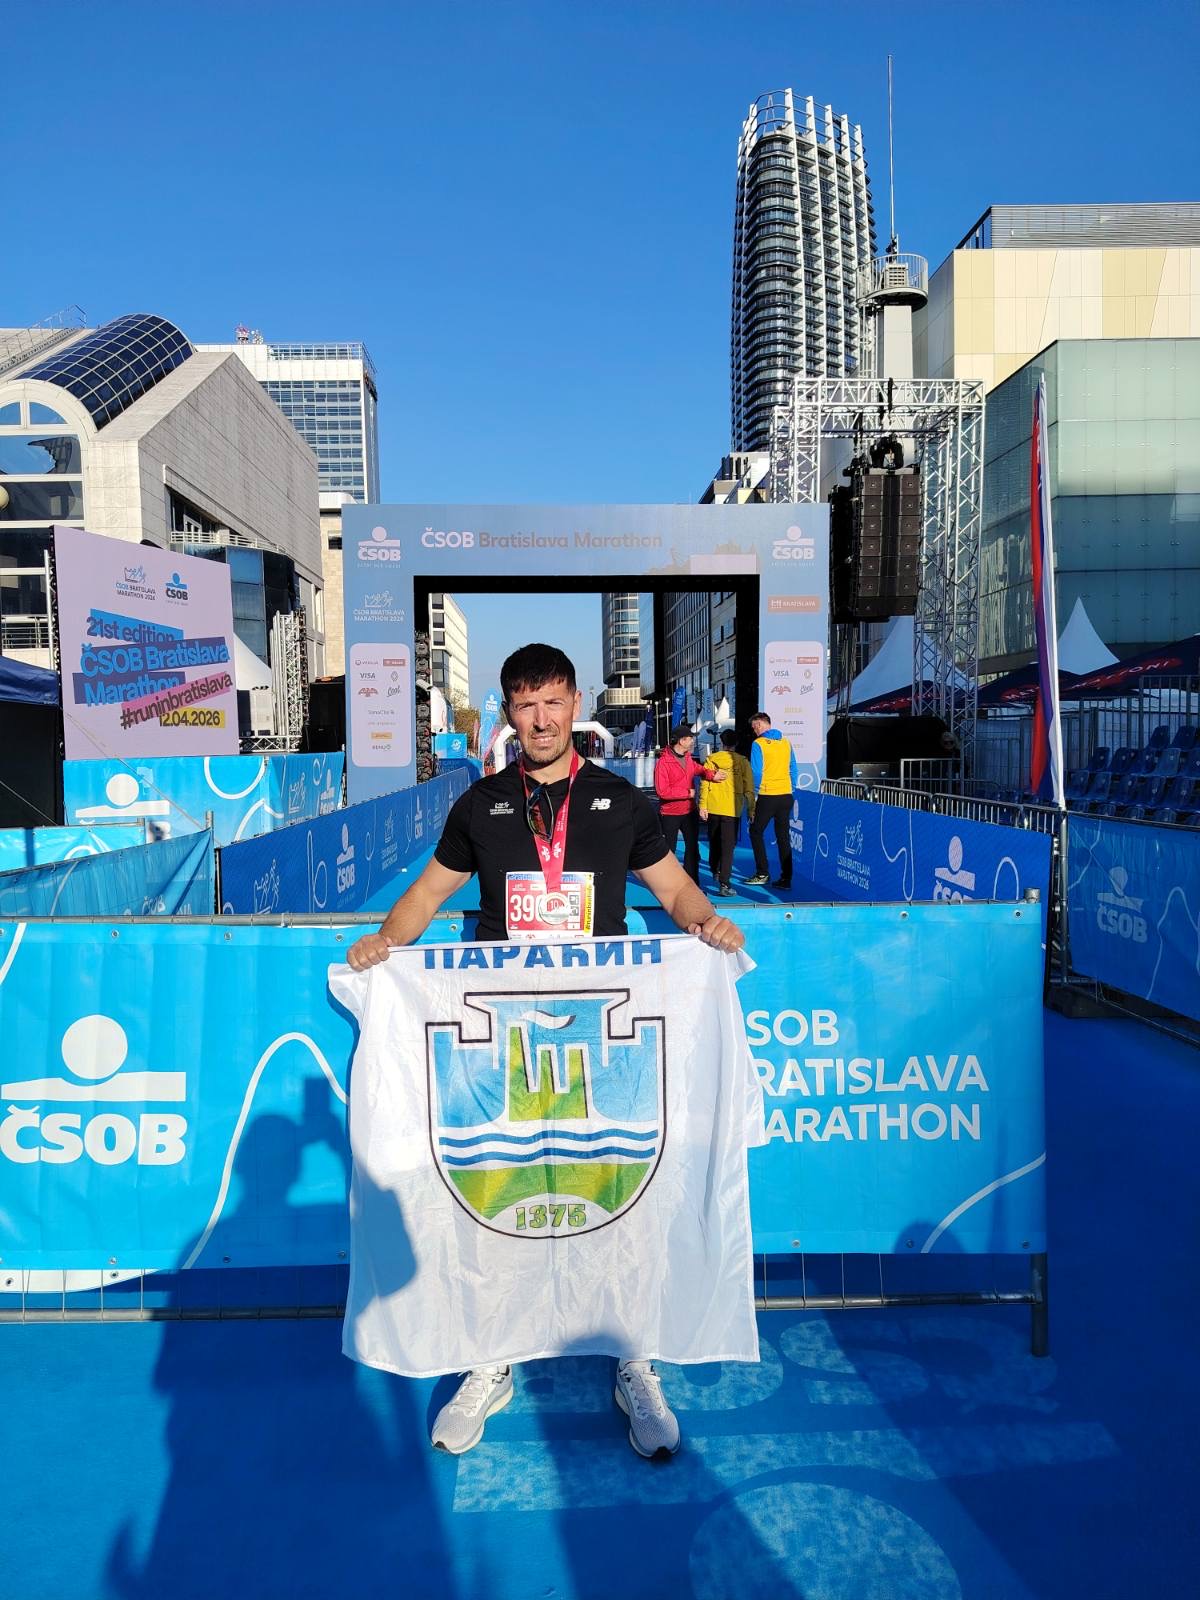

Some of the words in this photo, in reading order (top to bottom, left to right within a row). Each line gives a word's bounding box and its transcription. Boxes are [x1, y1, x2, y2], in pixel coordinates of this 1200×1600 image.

[421, 527, 475, 548] ČSOB
[478, 532, 569, 548] Bratislava
[574, 532, 663, 548] Marathon
[772, 546, 815, 560] ČSOB
[357, 546, 401, 562] ČSOB
[165, 587, 188, 601] ČSOB
[86, 616, 120, 641] 21st
[122, 623, 175, 643] edition
[80, 643, 143, 678] ČSOB
[145, 641, 230, 671] Bratislava
[83, 674, 180, 707] Marathon
[120, 672, 233, 729] #runinbratislava
[160, 710, 221, 727] 12.04.2026
[336, 863, 355, 893] ČSOB
[1097, 903, 1148, 944] ČSOB
[746, 1009, 840, 1047] SOB
[752, 1055, 990, 1098] RATISLAVA
[0, 1104, 188, 1166] ČSOB
[764, 1102, 981, 1144] ARATHON
[515, 1203, 587, 1231] 1375
